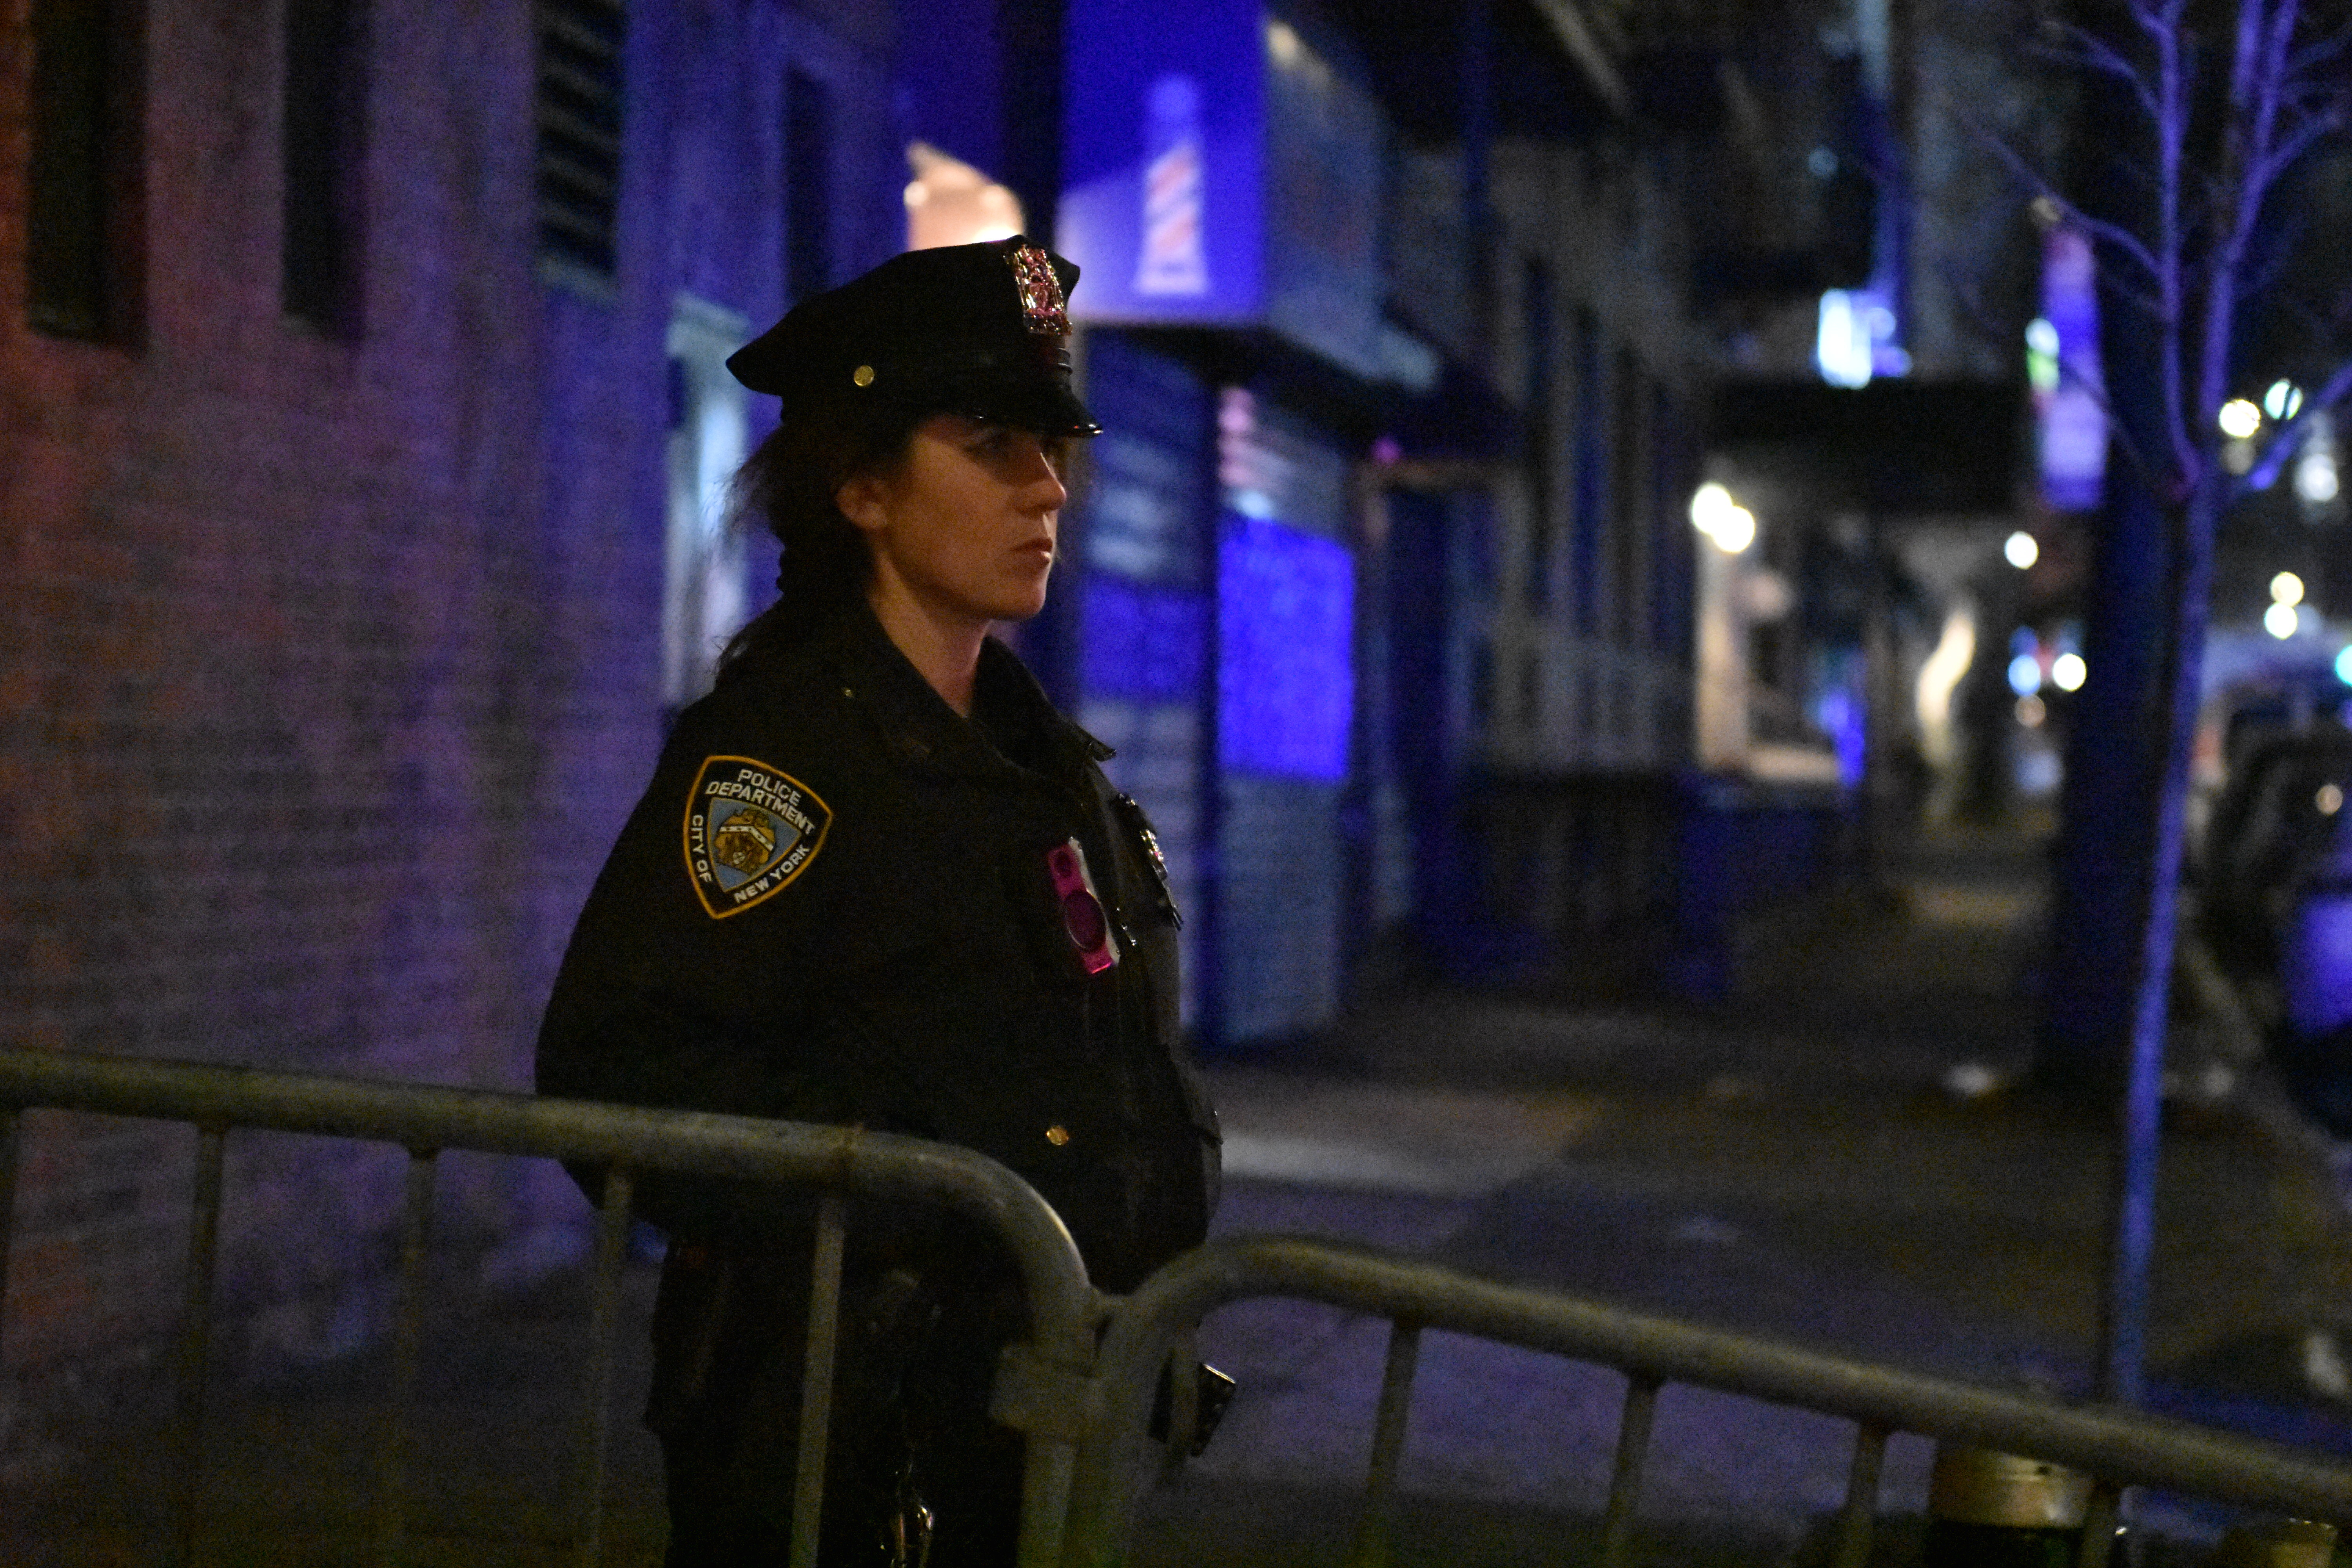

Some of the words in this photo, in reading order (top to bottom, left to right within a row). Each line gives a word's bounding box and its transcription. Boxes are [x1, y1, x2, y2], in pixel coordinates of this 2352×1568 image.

[738, 769, 802, 806] POLICE
[705, 781, 815, 835] DEPARTMENT
[691, 815, 704, 855] CITY
[697, 860, 712, 882] OF
[734, 878, 769, 903] NEW
[771, 844, 810, 880] YORK
